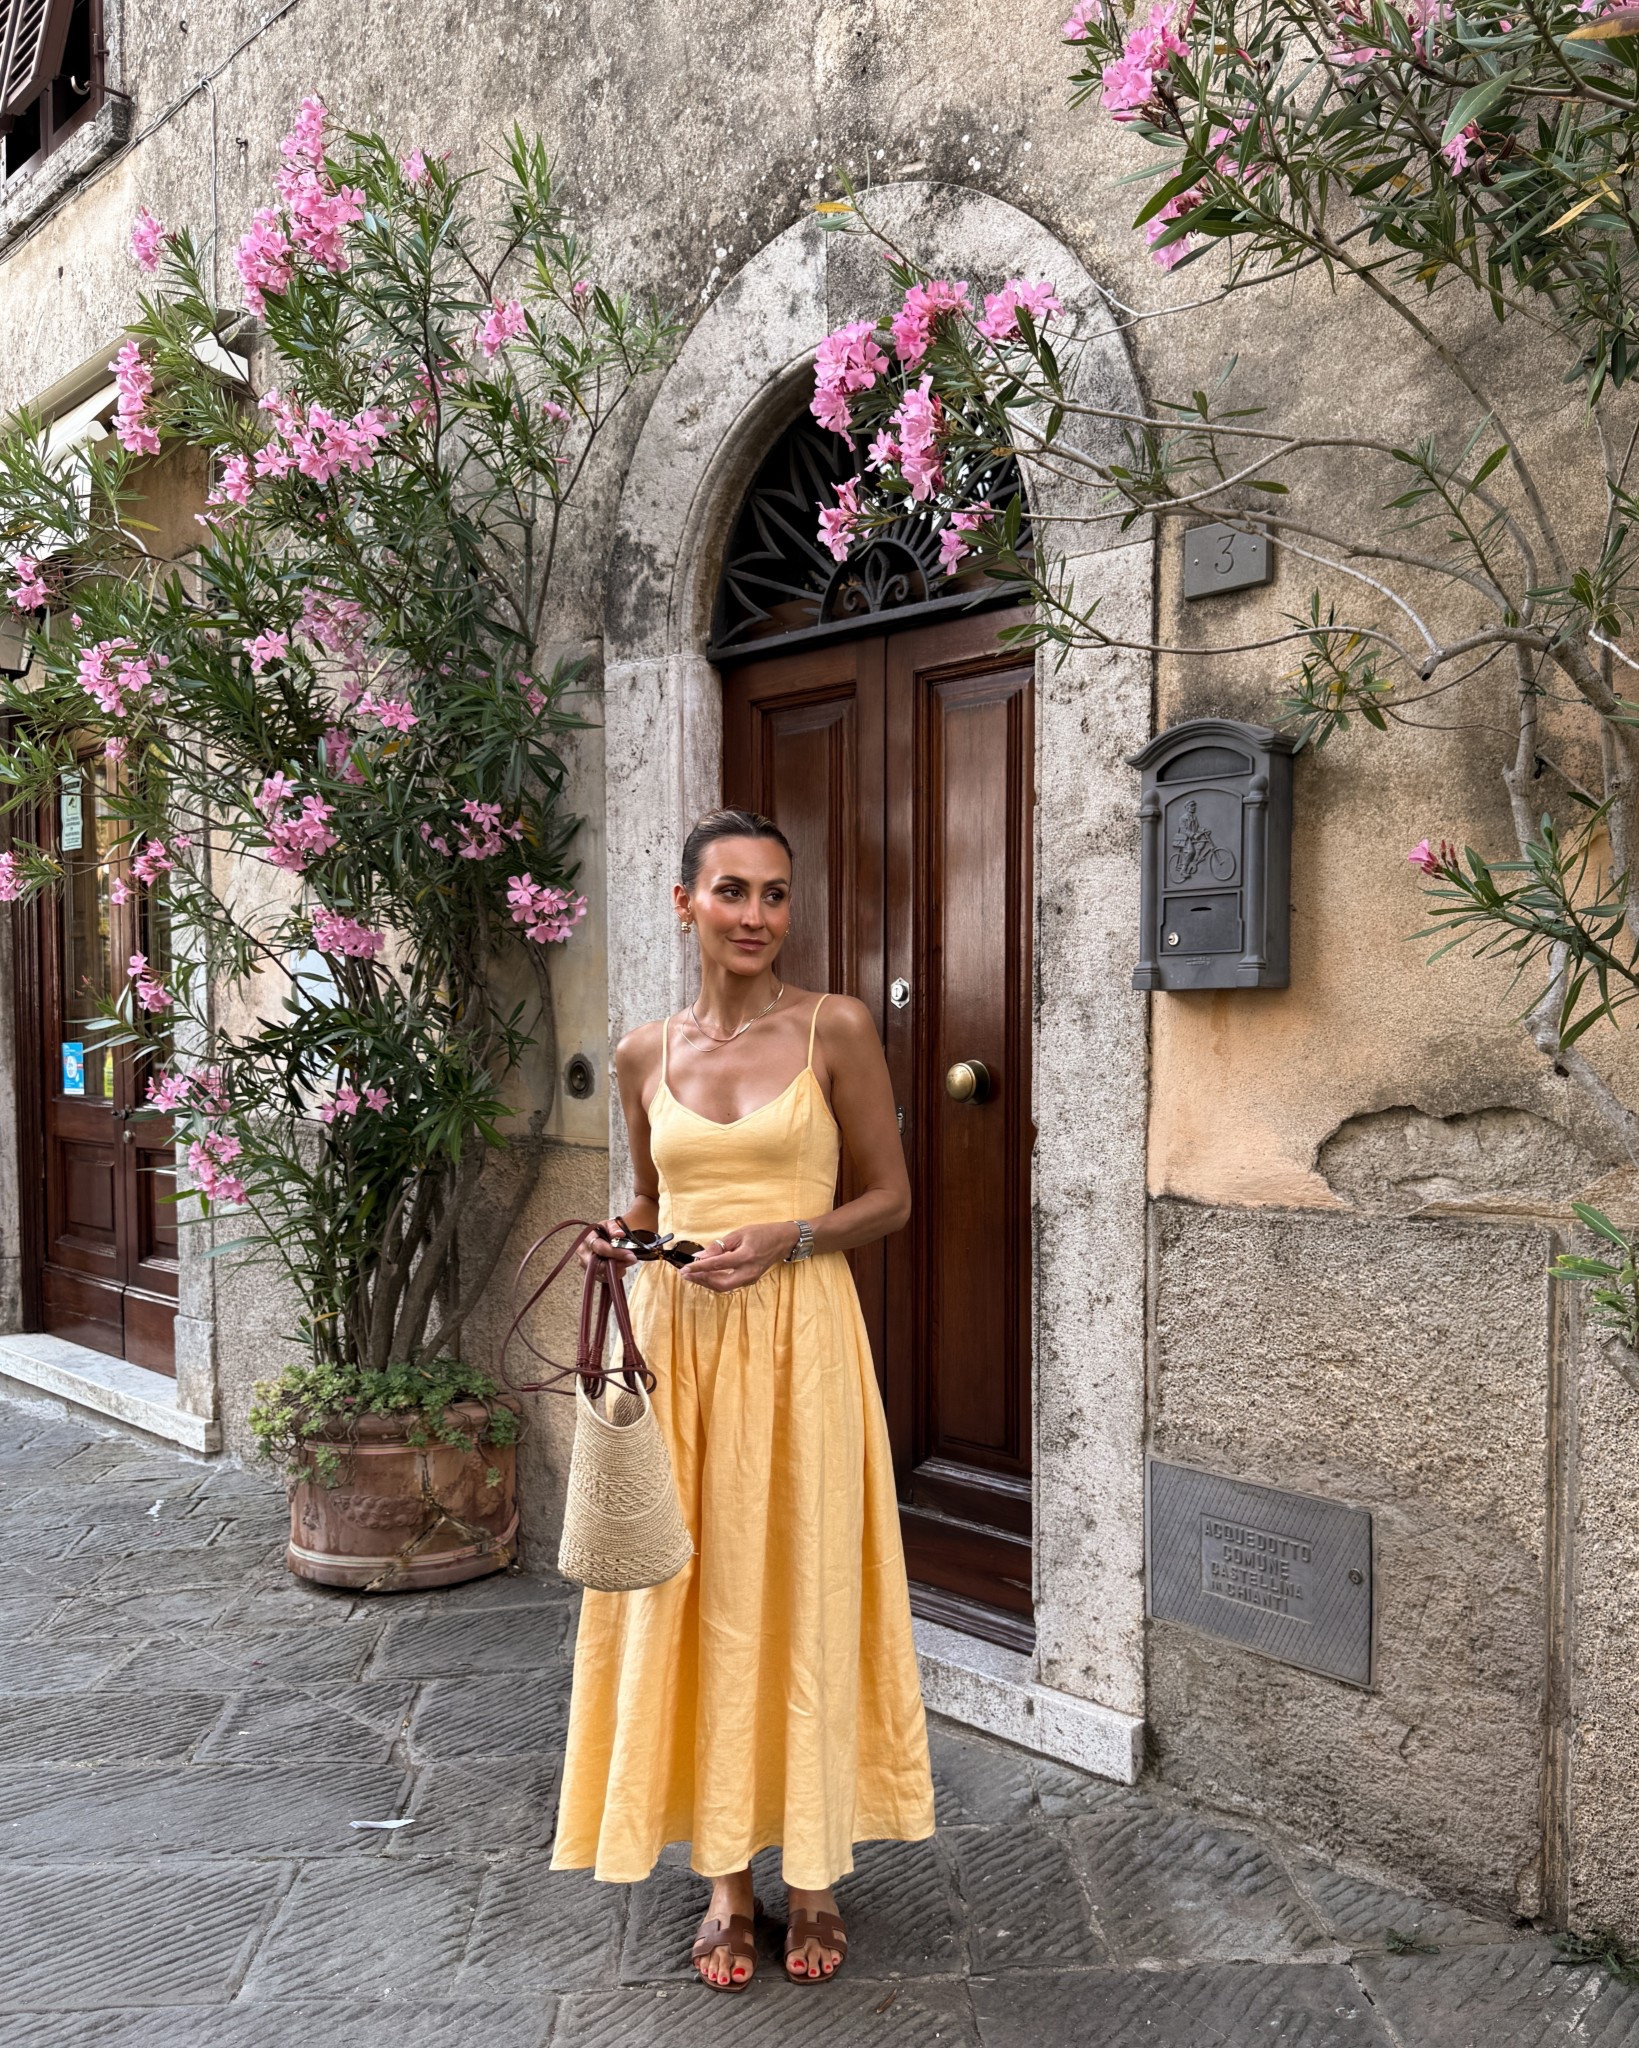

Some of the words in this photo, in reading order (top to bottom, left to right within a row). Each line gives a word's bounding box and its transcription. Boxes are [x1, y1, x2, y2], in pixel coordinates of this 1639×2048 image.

[1214, 533, 1236, 574] 3
[1205, 1519, 1311, 1563] ACQUEDOTTO
[1211, 1561, 1303, 1600] CASTELLINA
[1222, 1543, 1289, 1580] COMUNE
[1211, 1581, 1222, 1591] IN
[1226, 1581, 1288, 1613] CHIANTI
